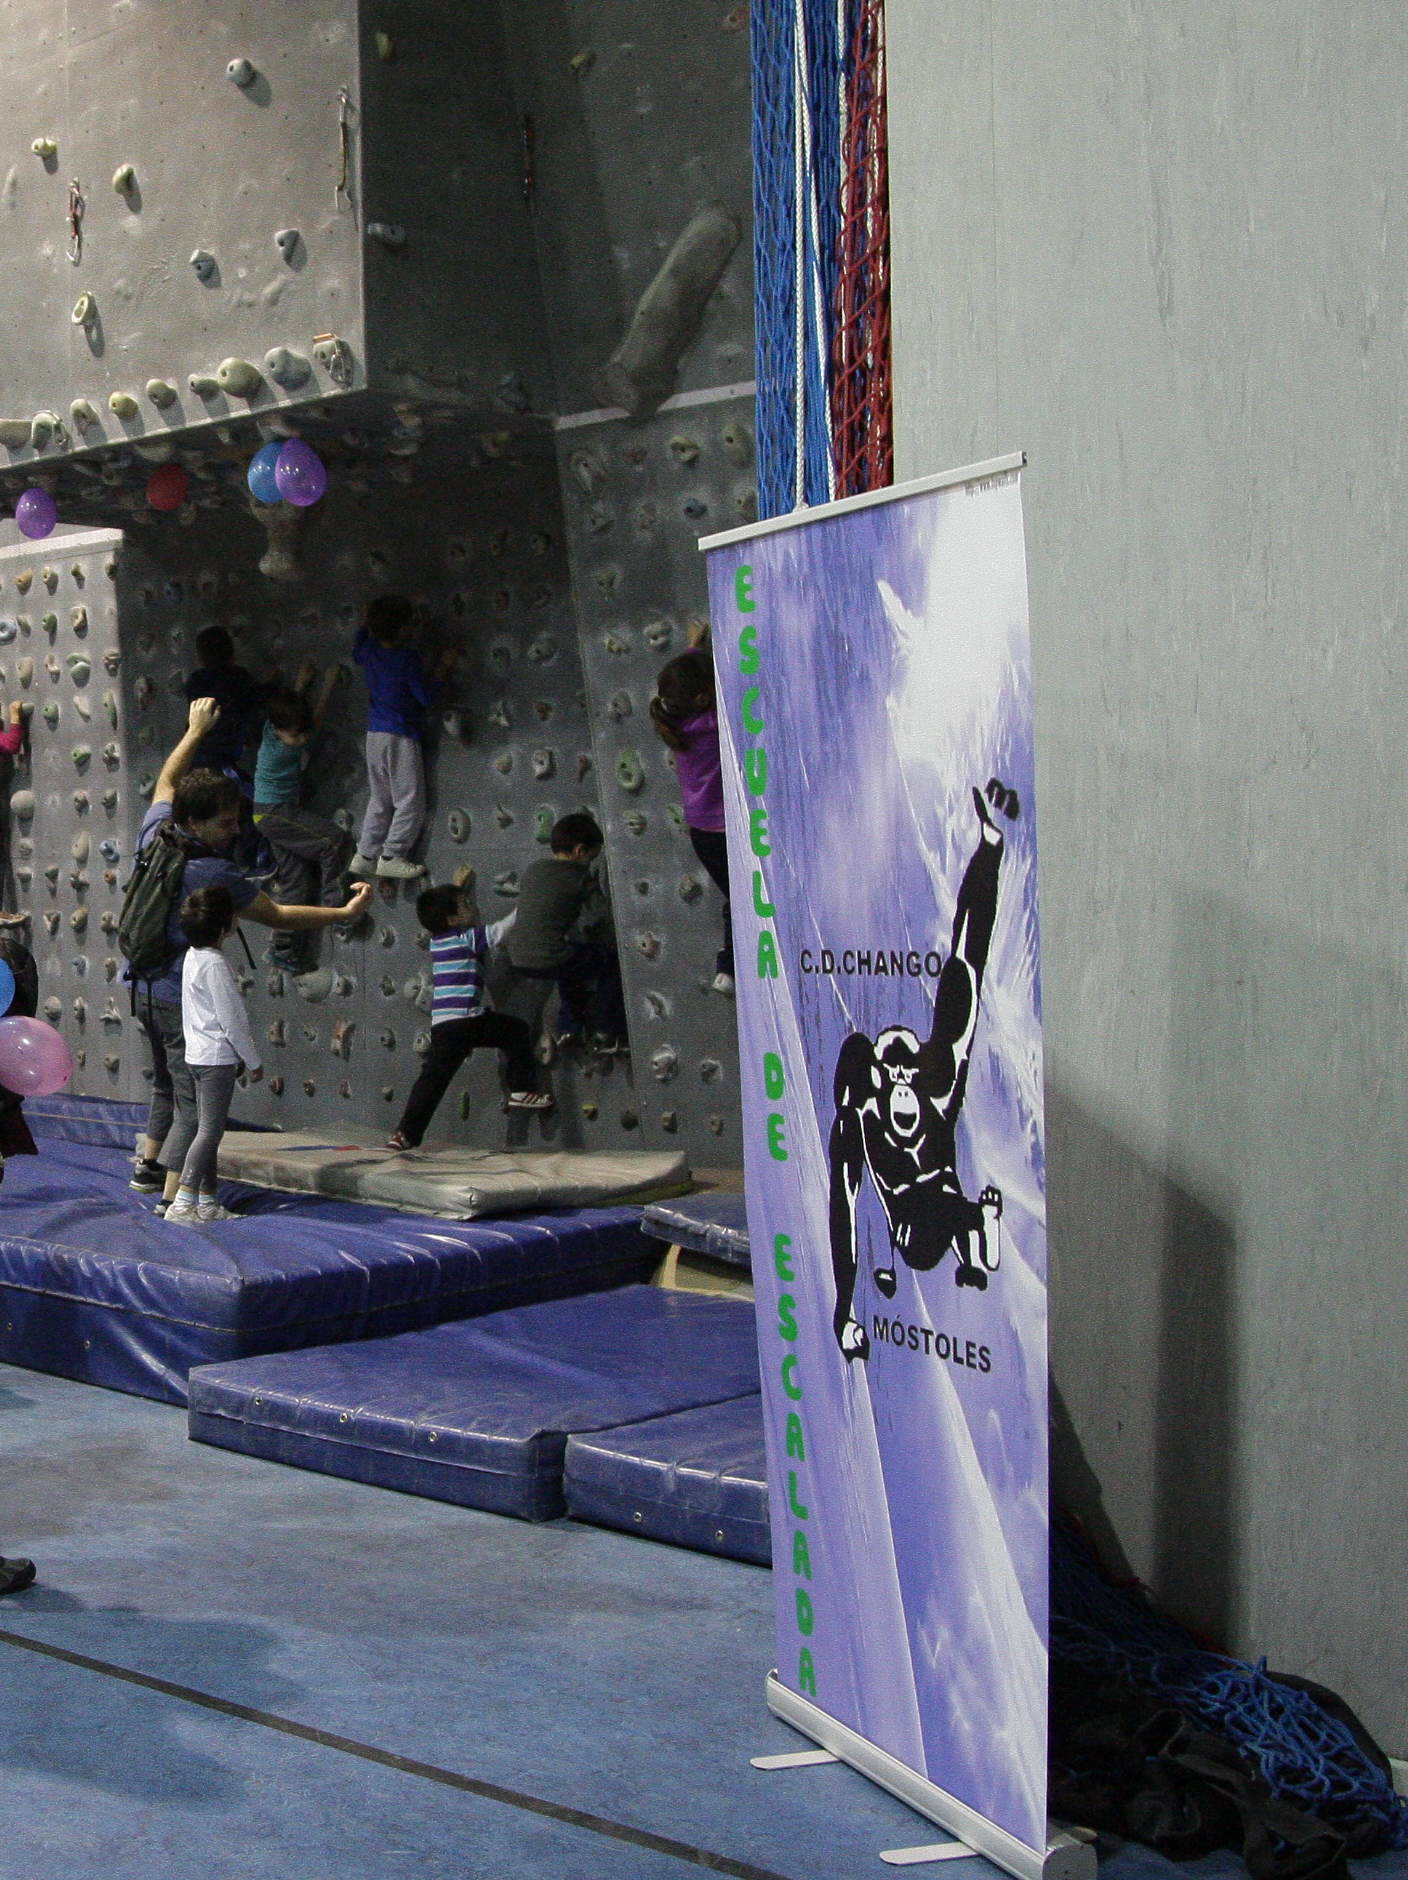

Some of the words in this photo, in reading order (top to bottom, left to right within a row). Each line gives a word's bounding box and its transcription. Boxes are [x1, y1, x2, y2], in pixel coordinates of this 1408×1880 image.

[735, 565, 779, 979] ESCUELA
[800, 949, 942, 978] C.D.CHANGO
[764, 1052, 789, 1161] DE
[873, 1314, 991, 1374] MÓSTOLES
[774, 1233, 816, 1697] ESCALADA
